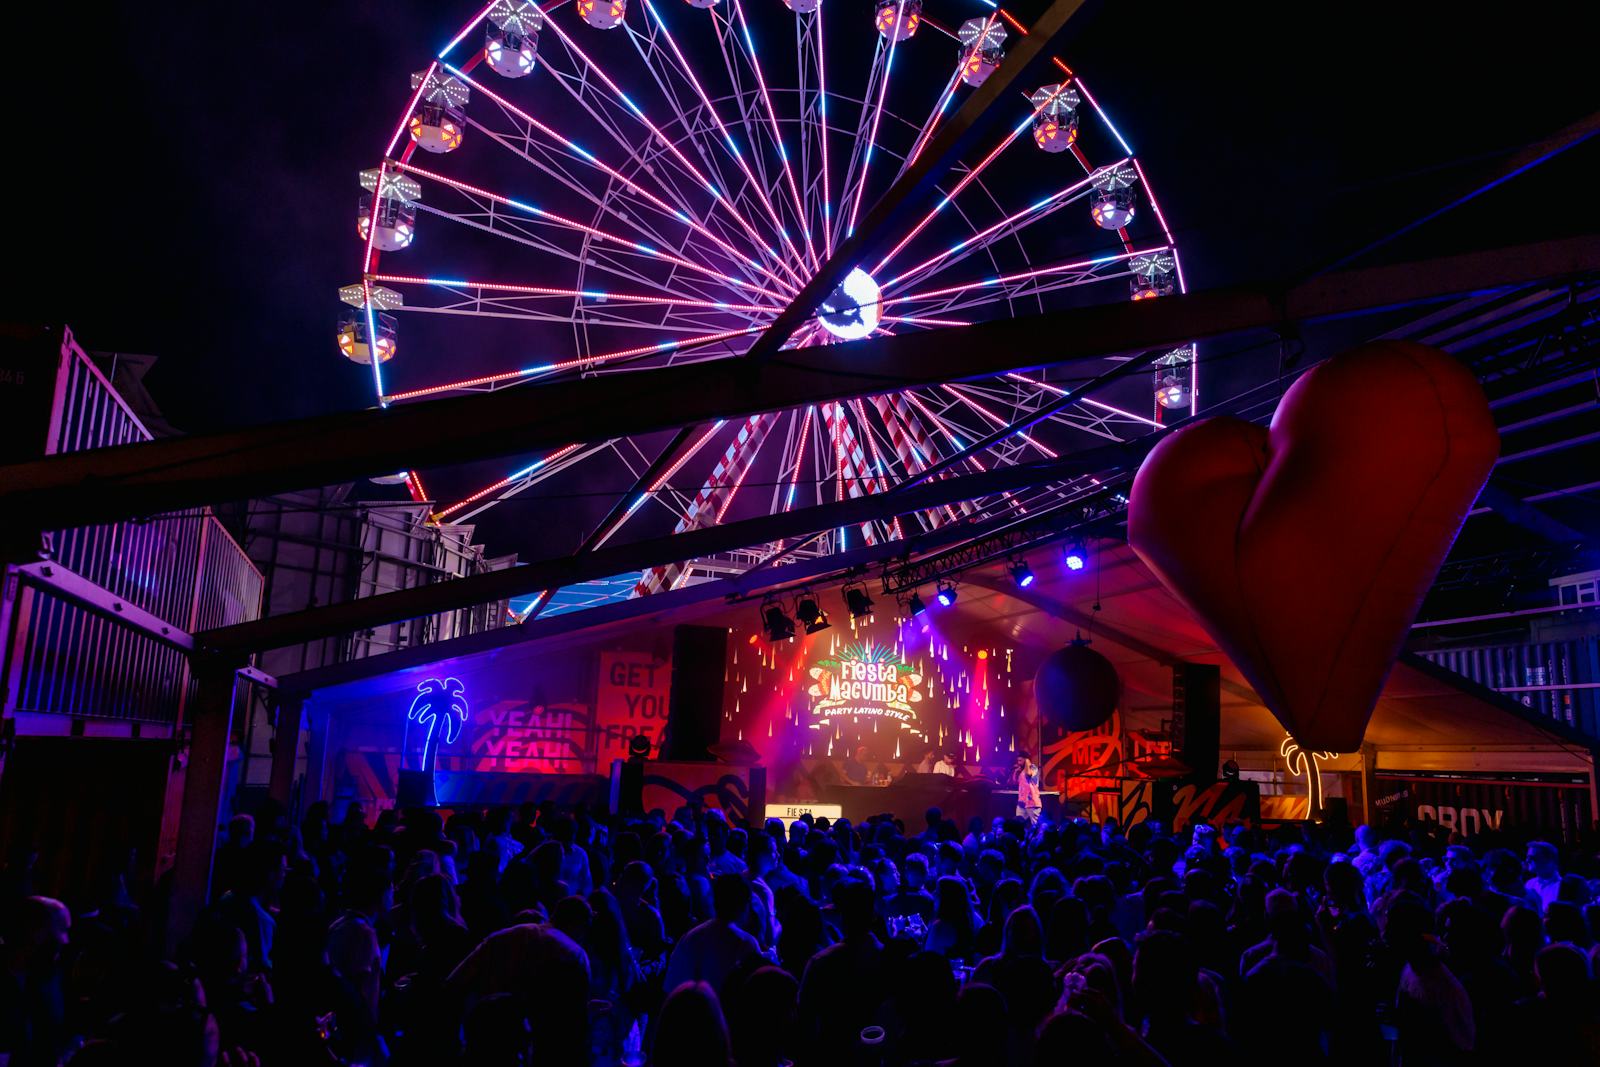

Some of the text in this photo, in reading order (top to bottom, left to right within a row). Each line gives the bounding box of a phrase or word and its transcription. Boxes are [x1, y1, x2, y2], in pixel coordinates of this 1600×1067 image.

[610, 662, 656, 688] GET
[841, 660, 897, 682] Fiesta
[829, 674, 907, 703] Macumba
[825, 707, 910, 721] PARTY LATINO STYLE
